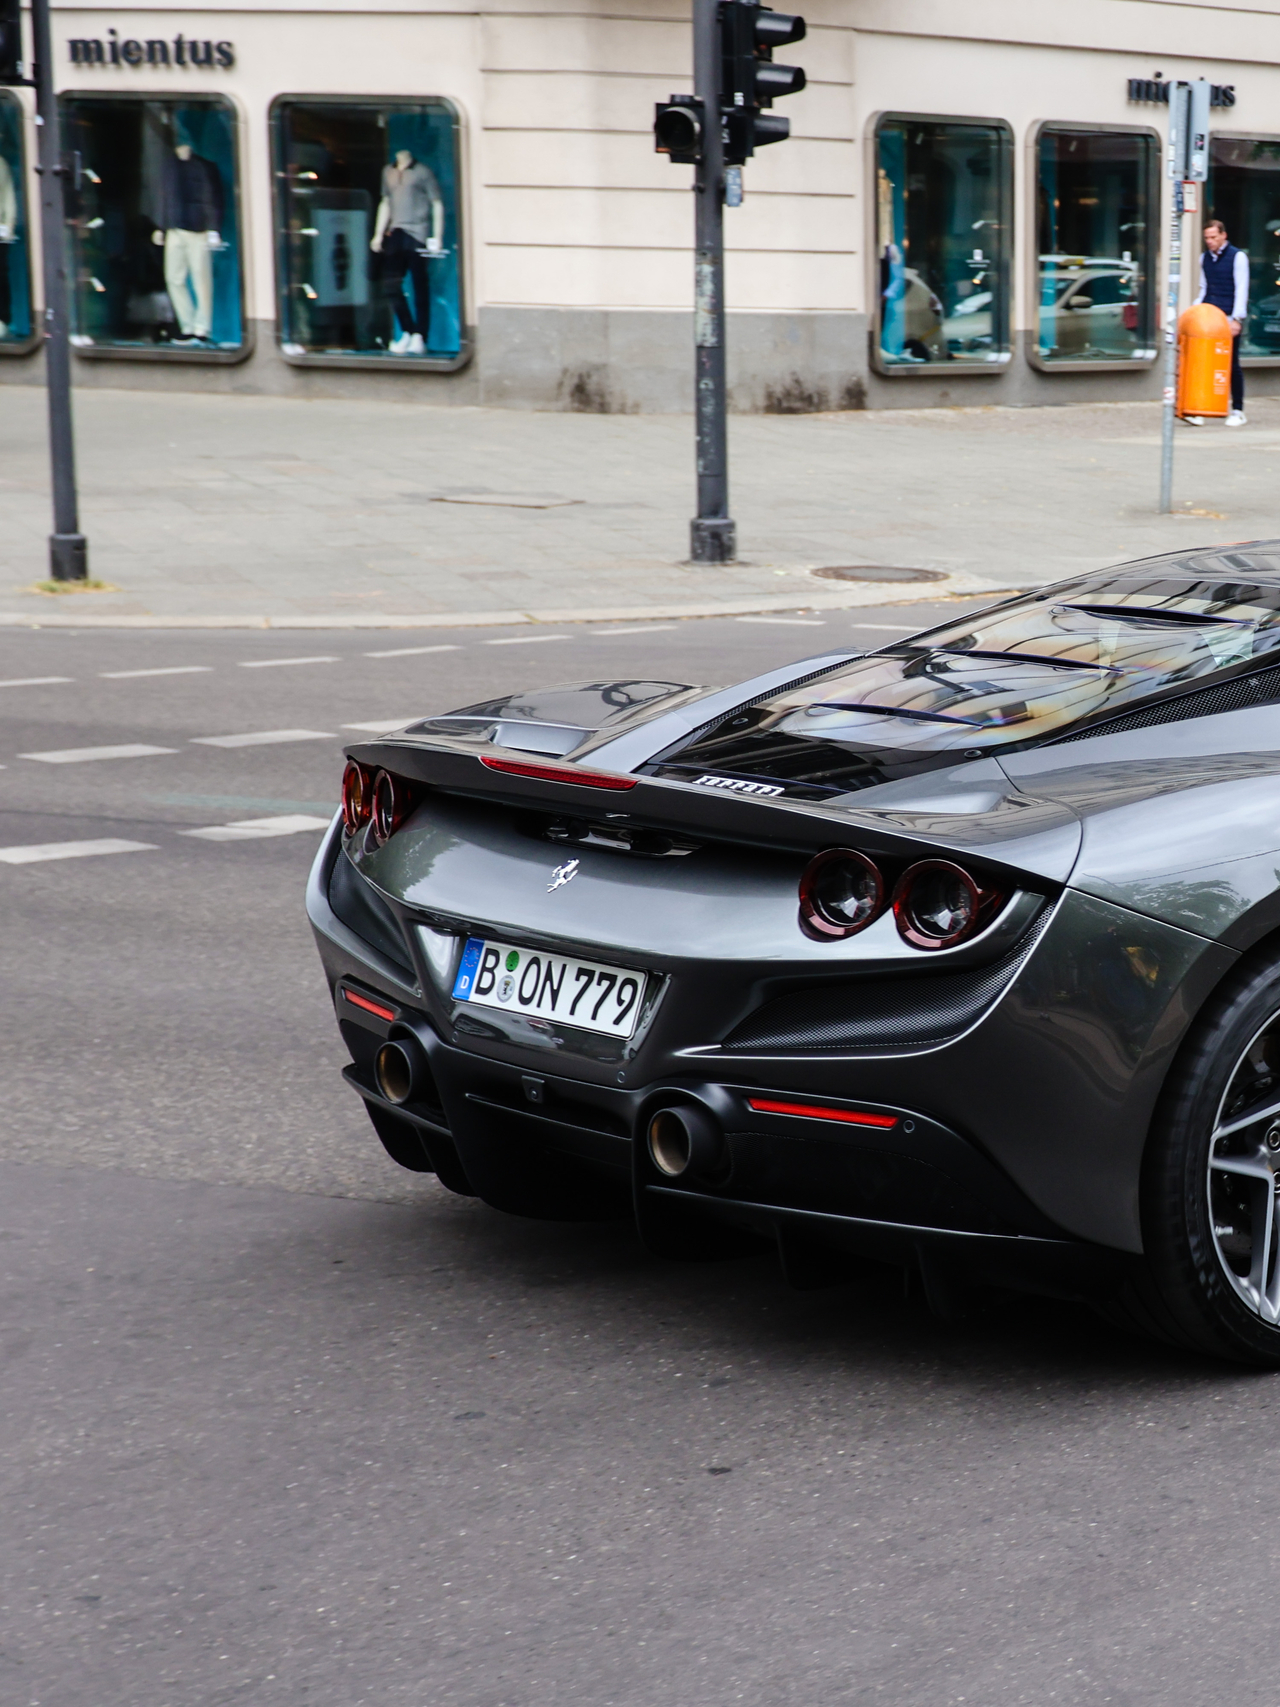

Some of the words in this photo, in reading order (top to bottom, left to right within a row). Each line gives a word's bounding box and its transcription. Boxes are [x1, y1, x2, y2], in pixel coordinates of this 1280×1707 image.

[67, 28, 236, 67] mientus
[1128, 71, 1236, 108] mius
[692, 775, 785, 796] Ferrari
[460, 975, 470, 989] D
[474, 947, 500, 995] B
[518, 956, 567, 1012] ON
[569, 966, 639, 1026] 779
